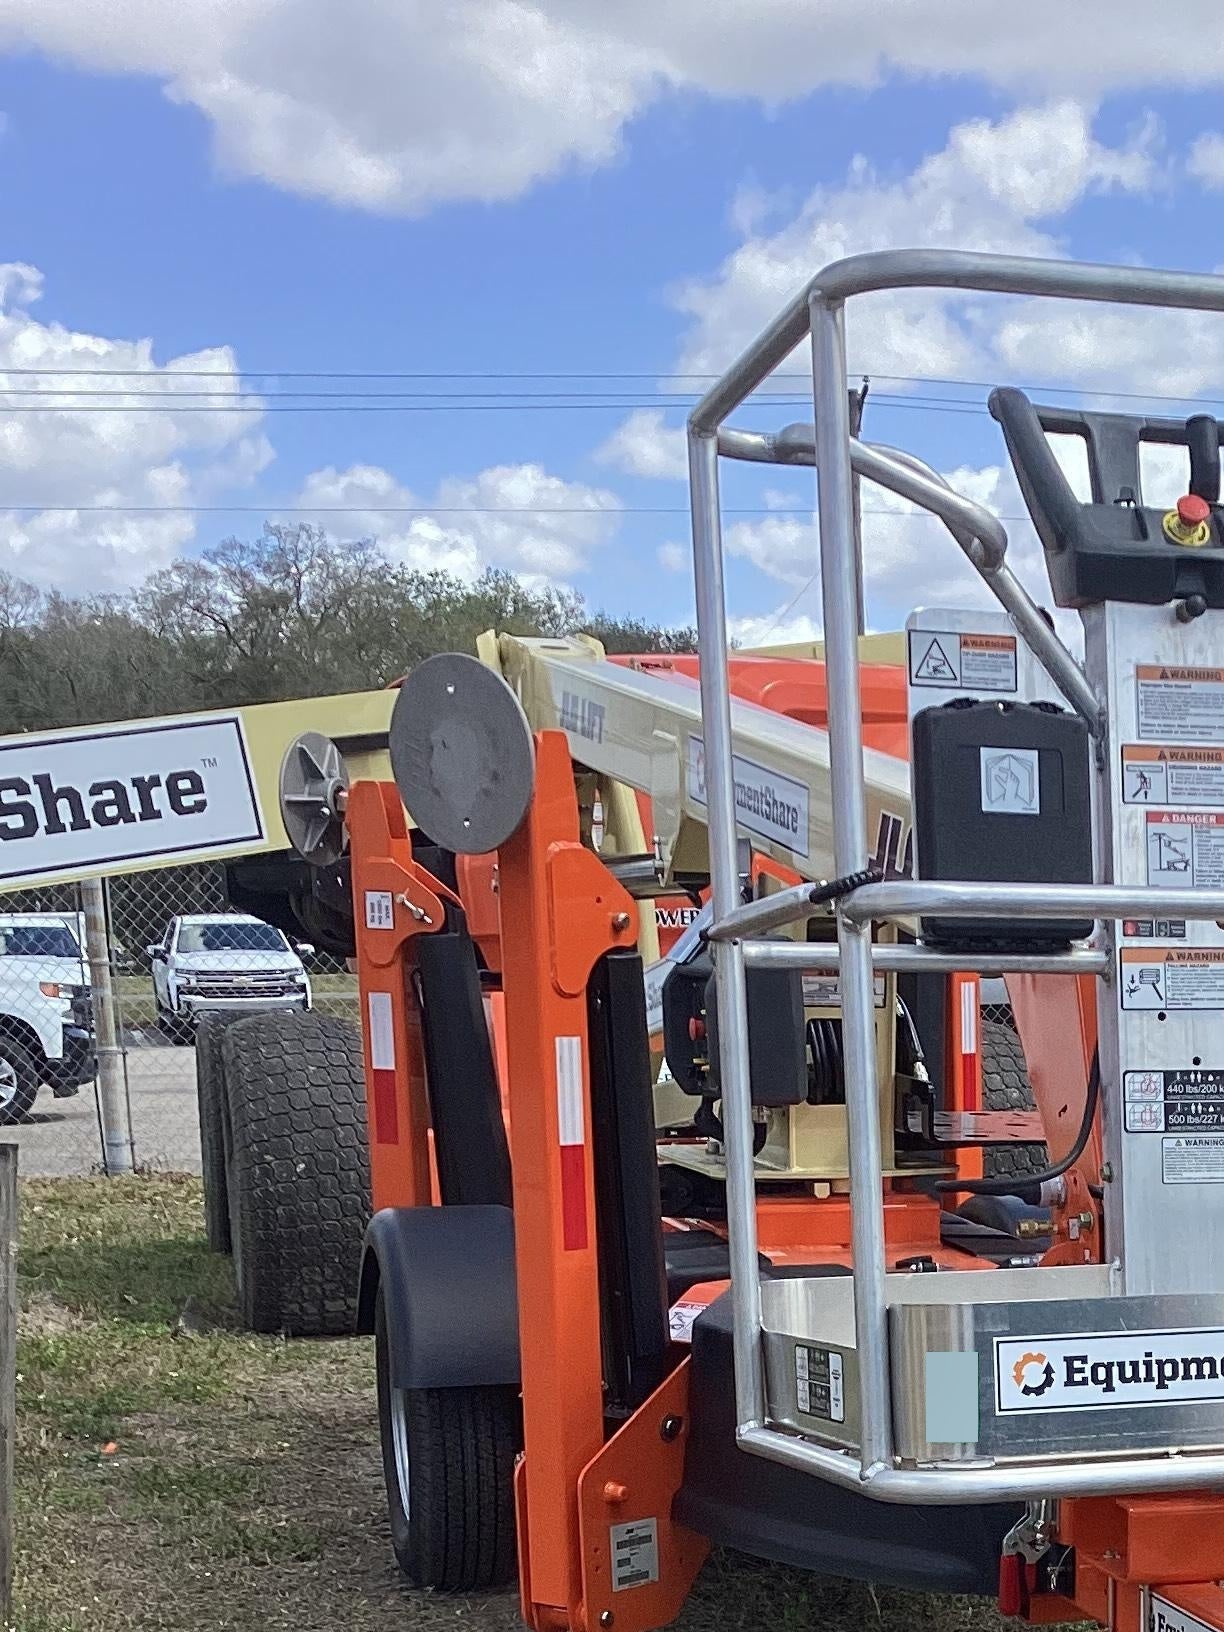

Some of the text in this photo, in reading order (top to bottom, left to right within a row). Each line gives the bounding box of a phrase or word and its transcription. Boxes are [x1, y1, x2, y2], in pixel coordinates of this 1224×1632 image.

[1170, 669, 1222, 681] WARNING
[1169, 751, 1222, 761] WARNING
[736, 783, 799, 834] mentShare
[1172, 813, 1217, 824] DANGER
[1166, 1085, 1184, 1094] 440
[1185, 1084, 1218, 1095] lbs/200
[1168, 1115, 1184, 1124] 500
[1186, 1114, 1218, 1124] lbs/227
